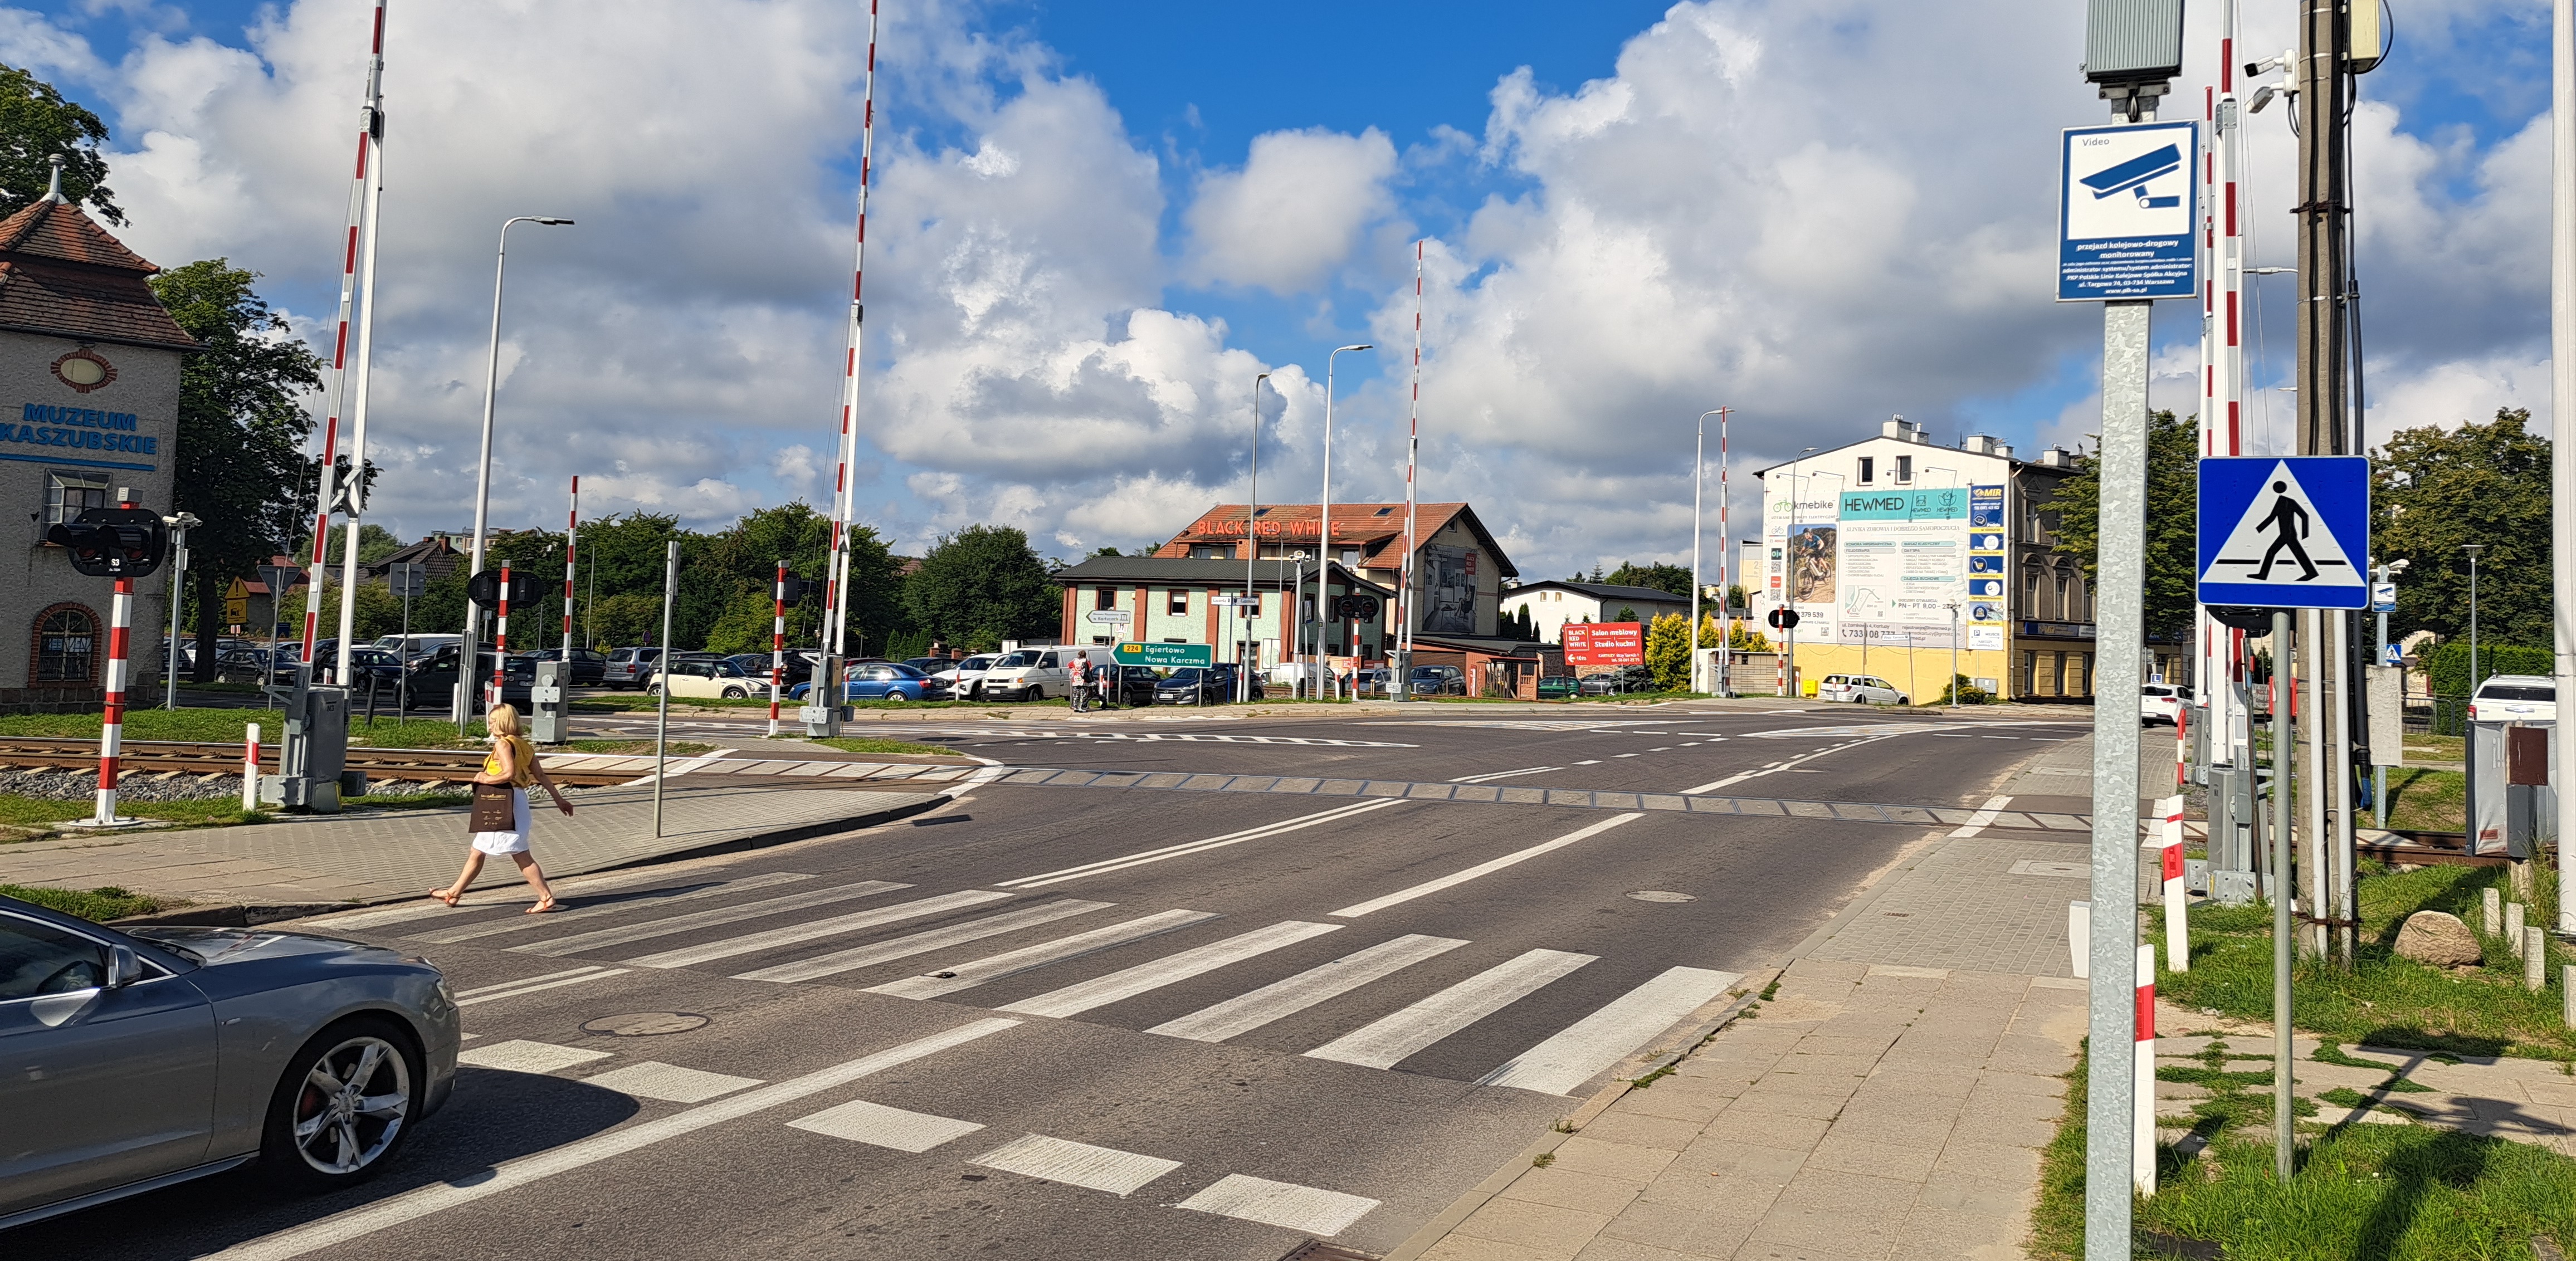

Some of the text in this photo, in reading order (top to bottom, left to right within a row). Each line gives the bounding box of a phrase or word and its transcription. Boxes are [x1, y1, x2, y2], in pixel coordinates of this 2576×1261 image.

[2082, 138, 2110, 146] Video
[2077, 240, 2179, 251] przejazd kolejowo-drogowy
[23, 403, 137, 431] MUZEUM
[0, 422, 158, 454] KASZUBSKIE
[1845, 497, 1904, 511] HEWMED
[1198, 521, 1341, 536] BLACK RED WHIE
[1609, 628, 1637, 637] meblowy
[1848, 629, 1863, 638] 733
[1145, 645, 1185, 654] Egiertowo
[1171, 655, 1206, 664] Karczma
